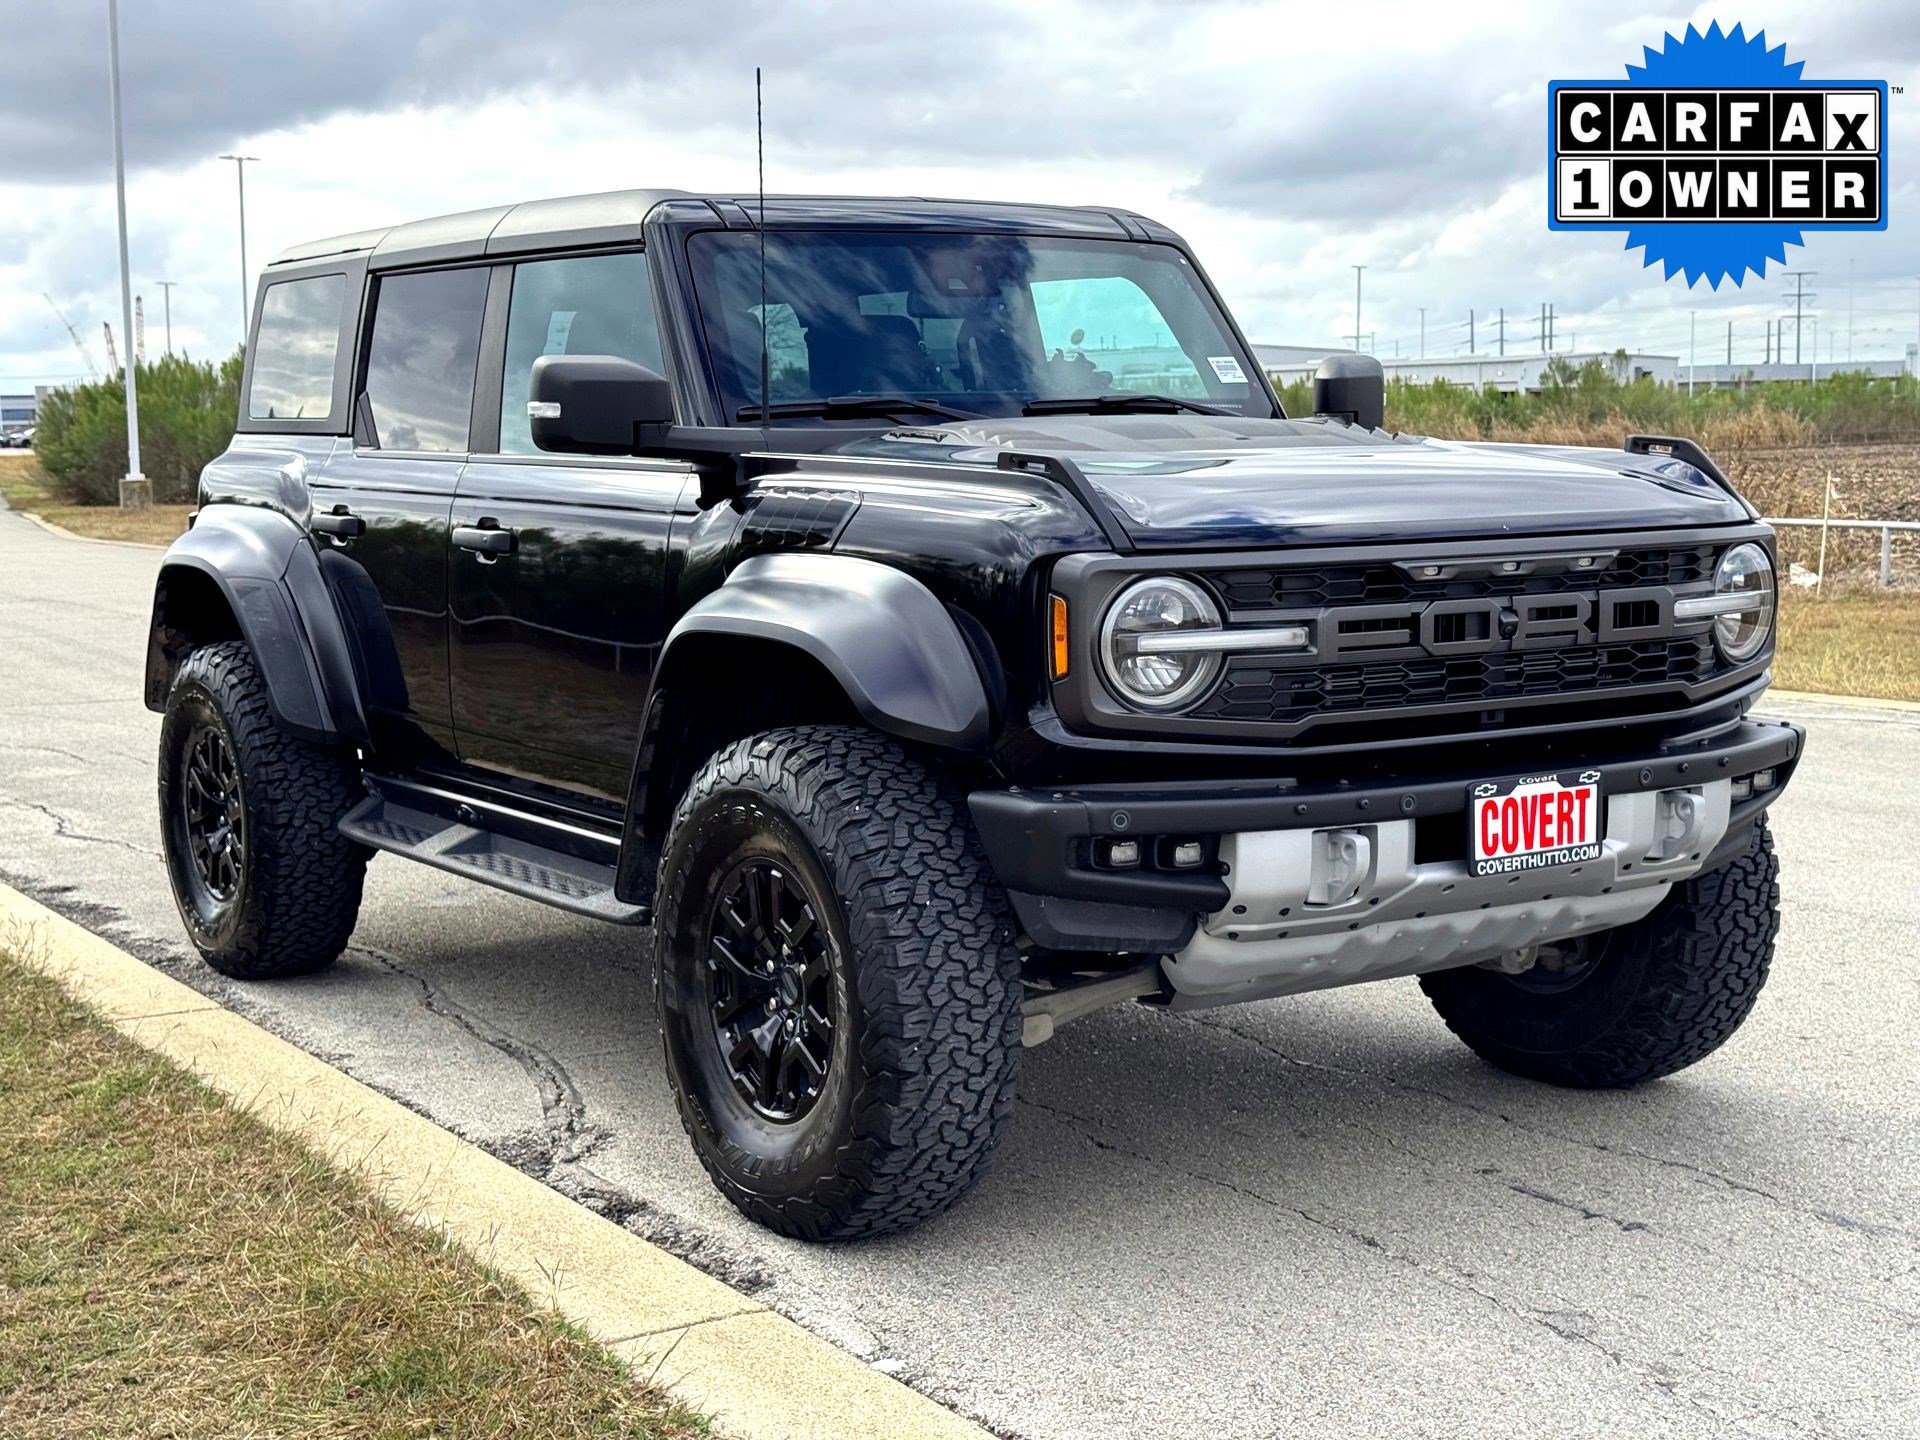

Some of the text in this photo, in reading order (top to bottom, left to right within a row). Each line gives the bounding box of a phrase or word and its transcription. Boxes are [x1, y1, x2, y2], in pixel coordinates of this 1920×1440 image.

[1323, 585, 1675, 665] FORD
[1518, 774, 1558, 786] Covert
[1481, 788, 1591, 857] COVERT
[1477, 845, 1600, 876] COVERTHUTTO.COM
